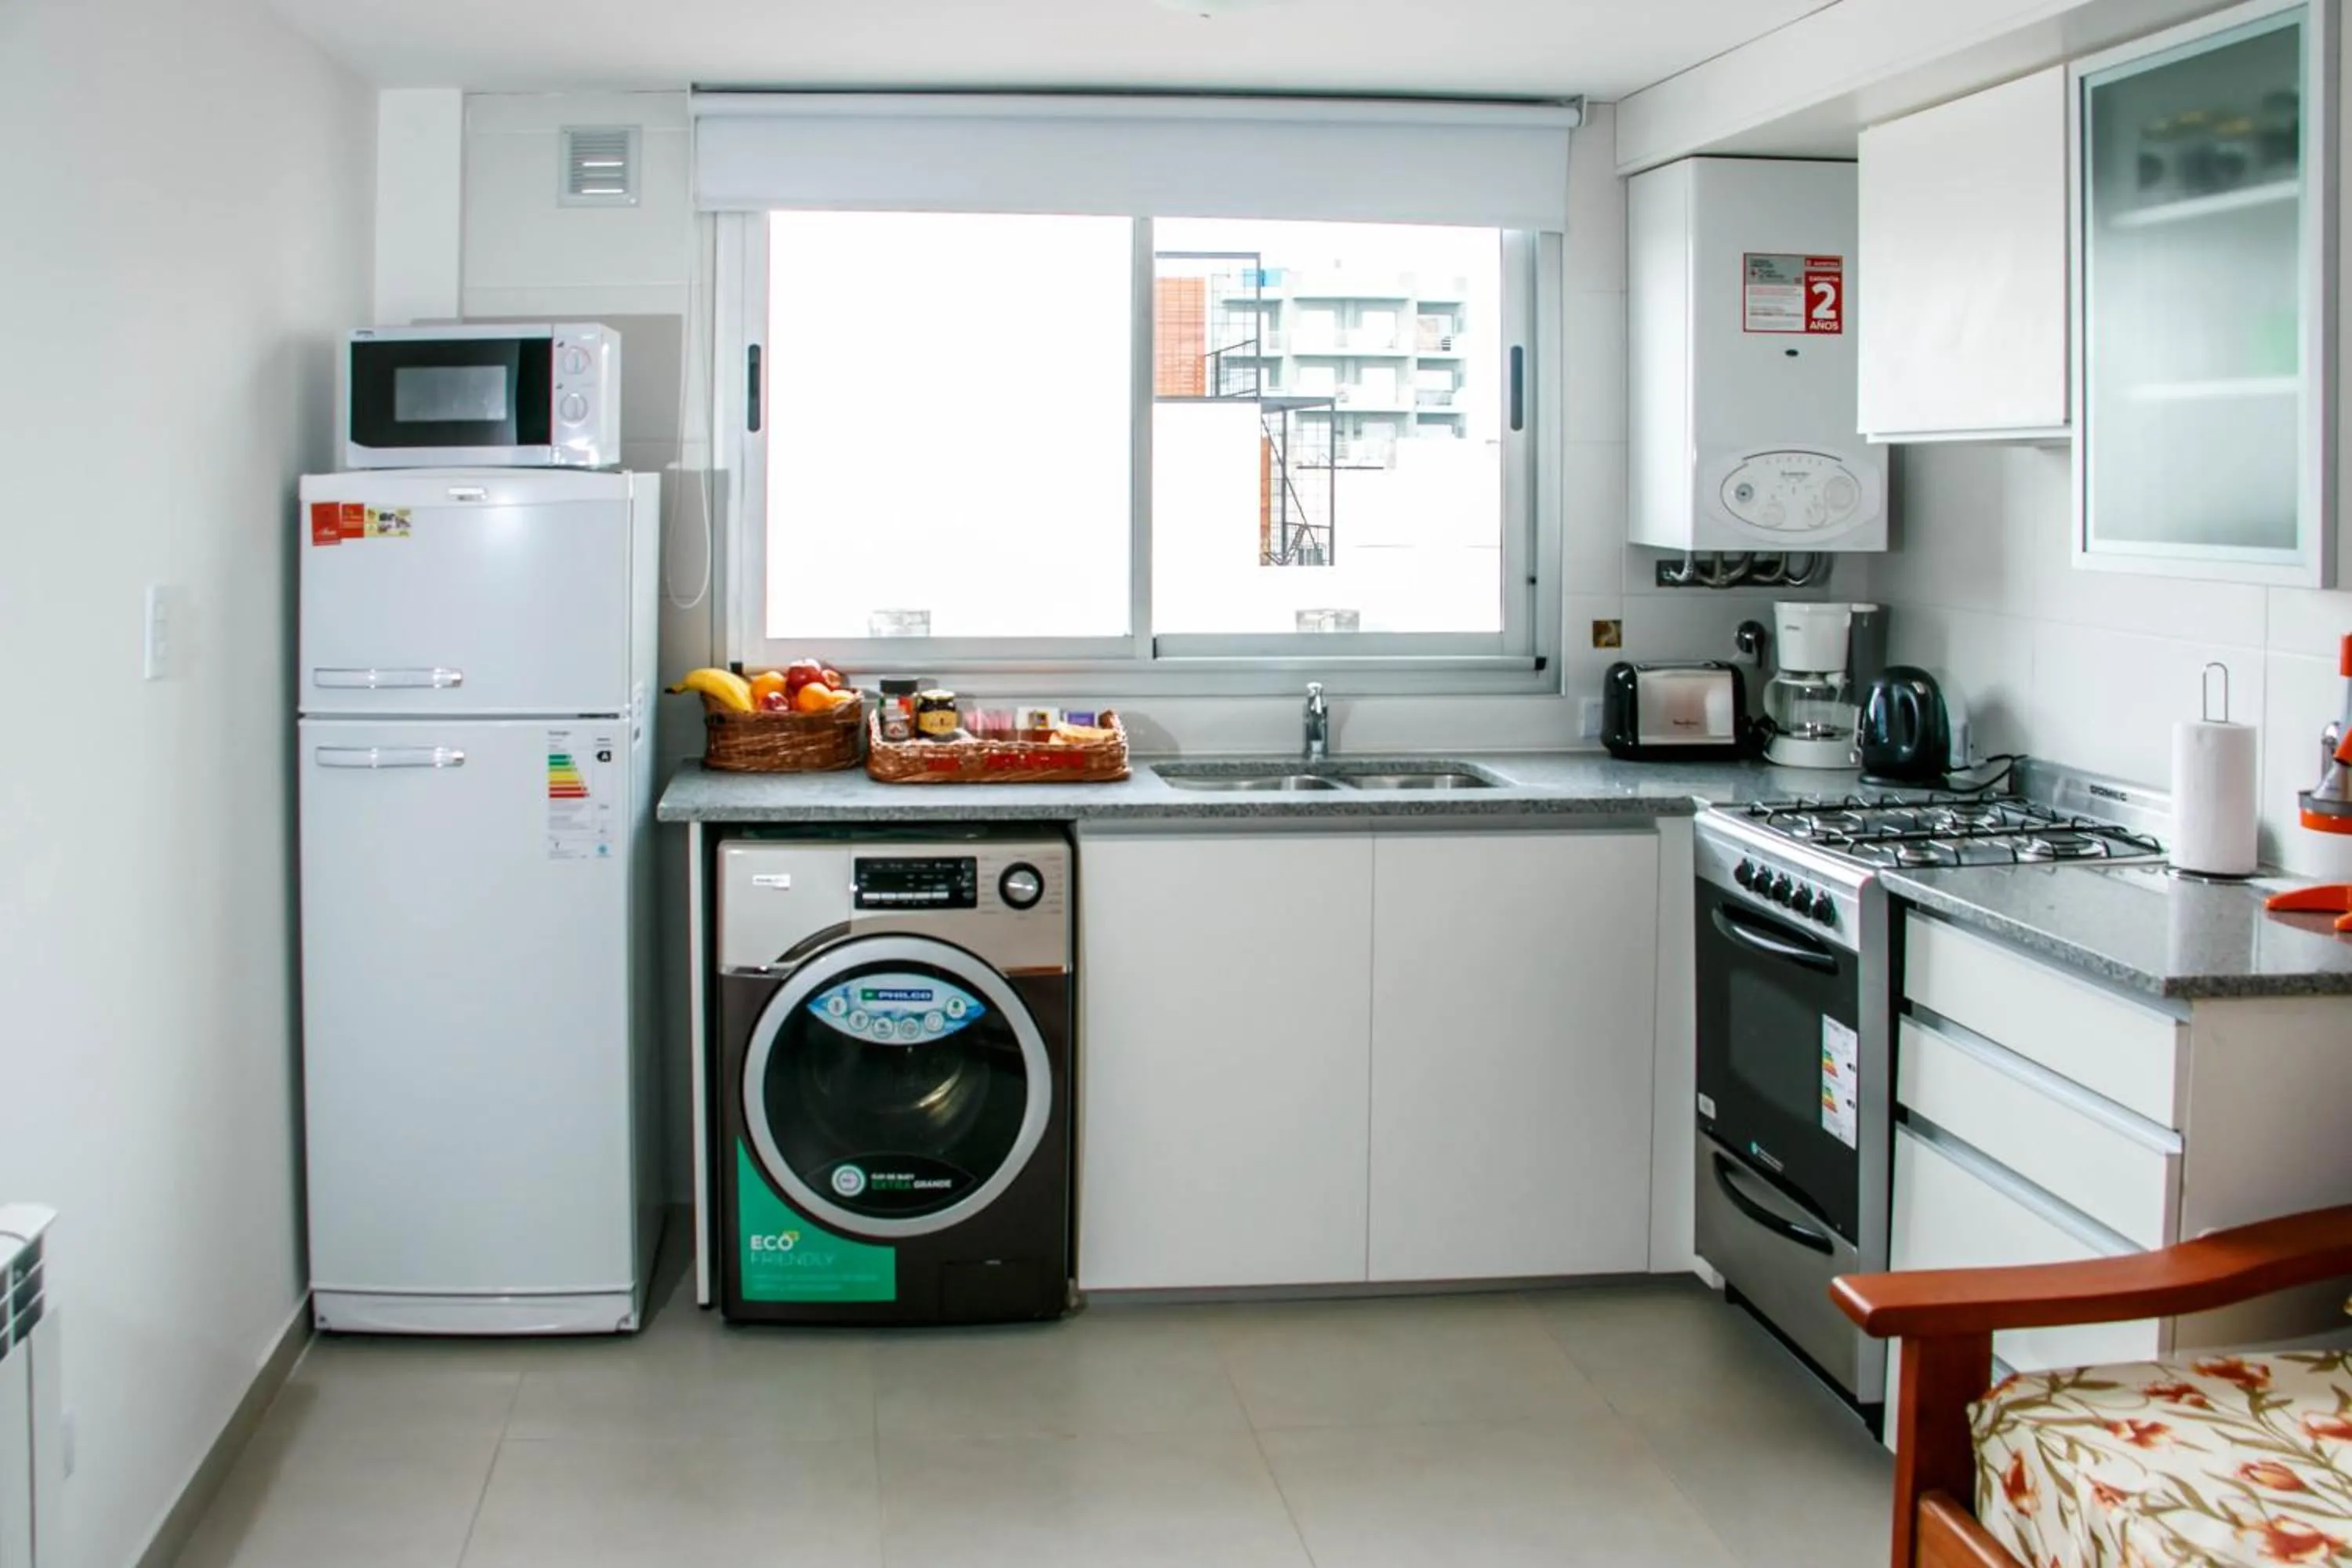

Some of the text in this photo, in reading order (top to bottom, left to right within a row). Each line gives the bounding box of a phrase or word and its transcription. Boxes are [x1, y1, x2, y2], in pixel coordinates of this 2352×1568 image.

[1812, 282, 1836, 320] 2
[1809, 319, 1838, 331] AÑOS
[877, 991, 931, 1000] PHILCO
[871, 1179, 952, 1189] EXTRA GRANDE
[750, 1235, 793, 1250] ECO
[750, 1252, 836, 1265] FRIENDLY
